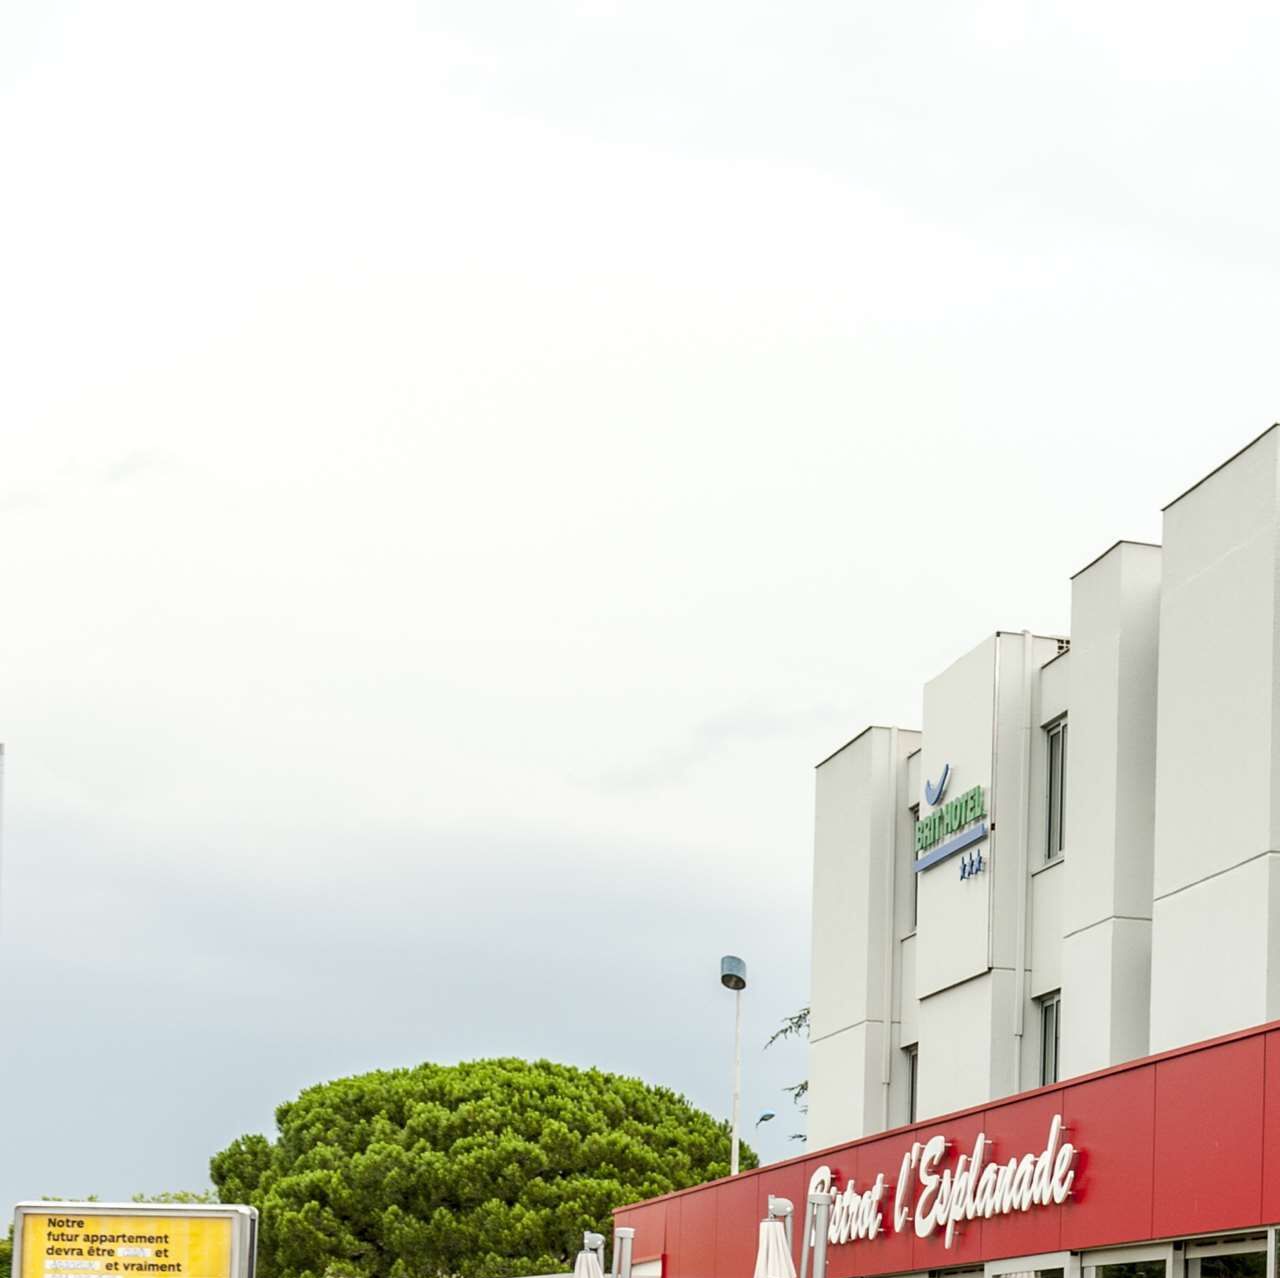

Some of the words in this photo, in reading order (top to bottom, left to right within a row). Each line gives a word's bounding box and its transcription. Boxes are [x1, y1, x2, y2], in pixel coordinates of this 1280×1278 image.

[914, 808, 943, 853] BRIT
[942, 785, 985, 836] HOTEL
[895, 1114, 1075, 1249] l'Esplanade
[47, 1218, 84, 1228] Notre
[47, 1231, 79, 1242] futur
[83, 1233, 169, 1245] appartement
[46, 1245, 83, 1256] devra
[87, 1246, 115, 1257] être
[155, 1248, 168, 1258] et
[105, 1262, 119, 1271] et
[123, 1261, 182, 1272] vraiment
